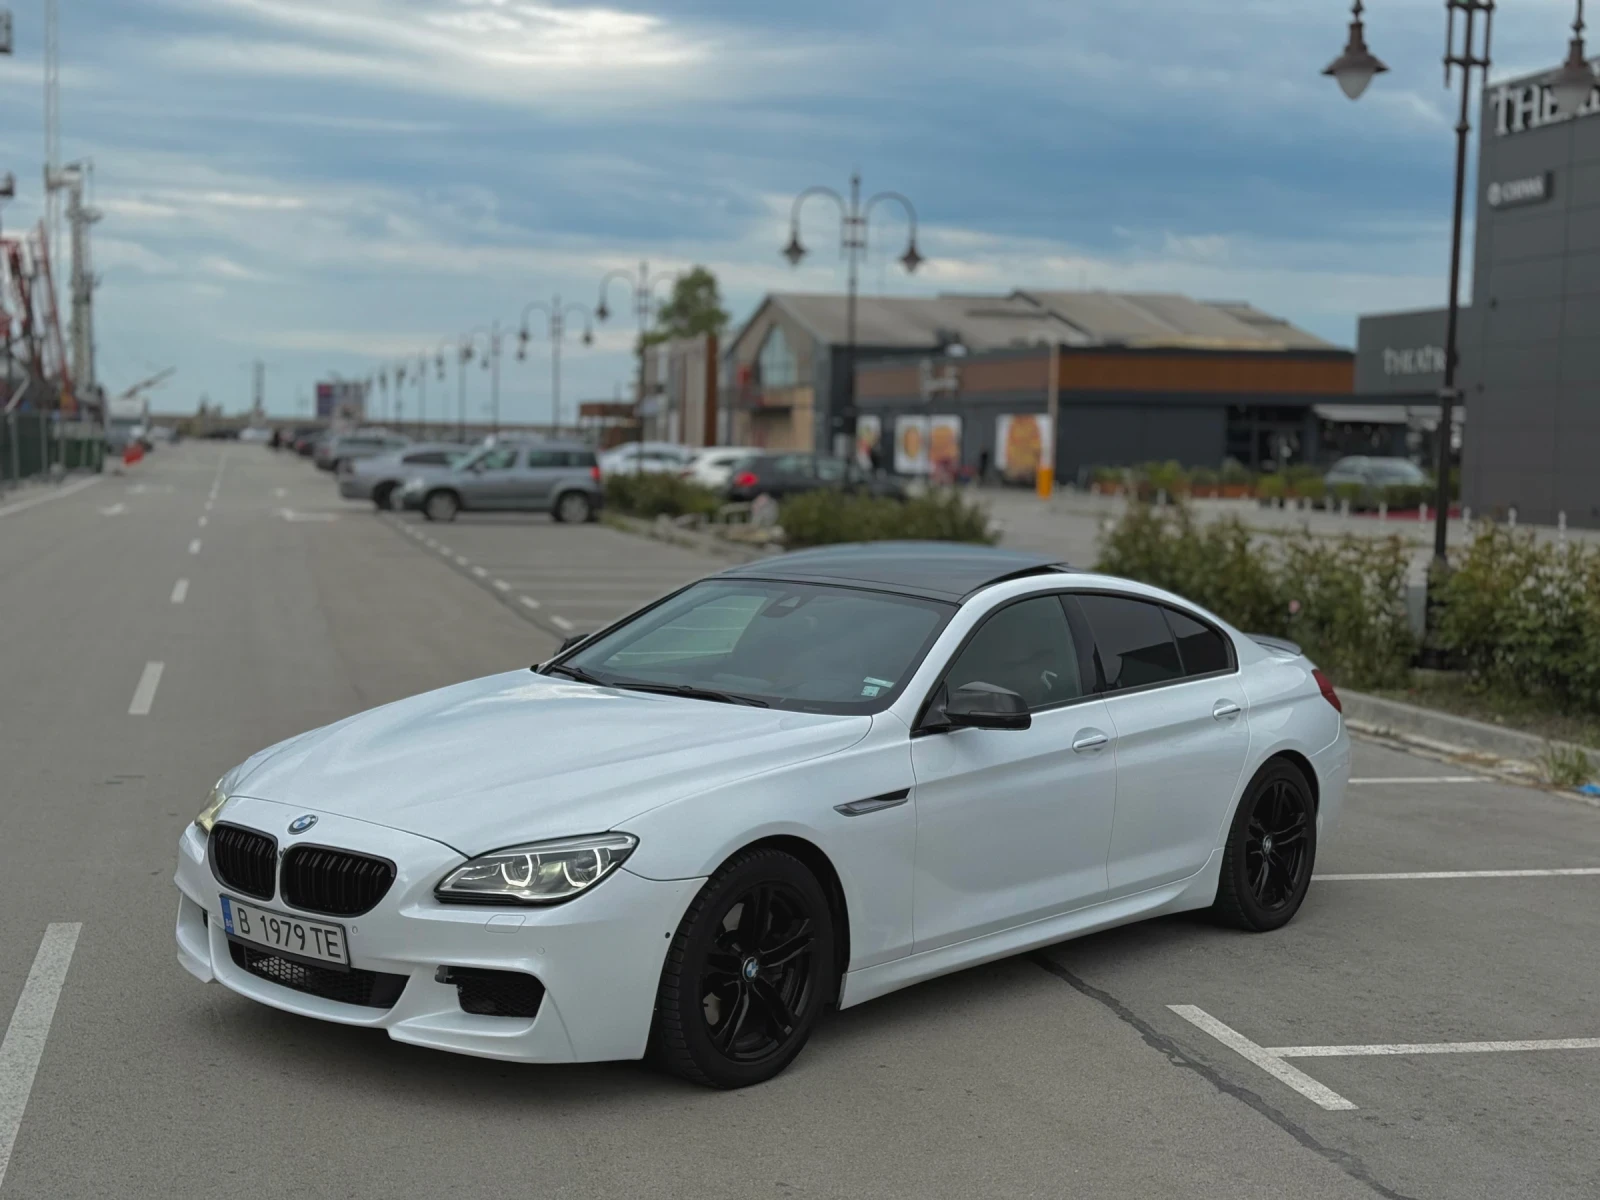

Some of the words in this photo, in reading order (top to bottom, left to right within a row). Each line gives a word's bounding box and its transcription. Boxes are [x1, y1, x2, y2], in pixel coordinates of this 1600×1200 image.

[237, 907, 251, 935] B
[260, 915, 306, 951] 1979
[309, 926, 341, 959] TE
